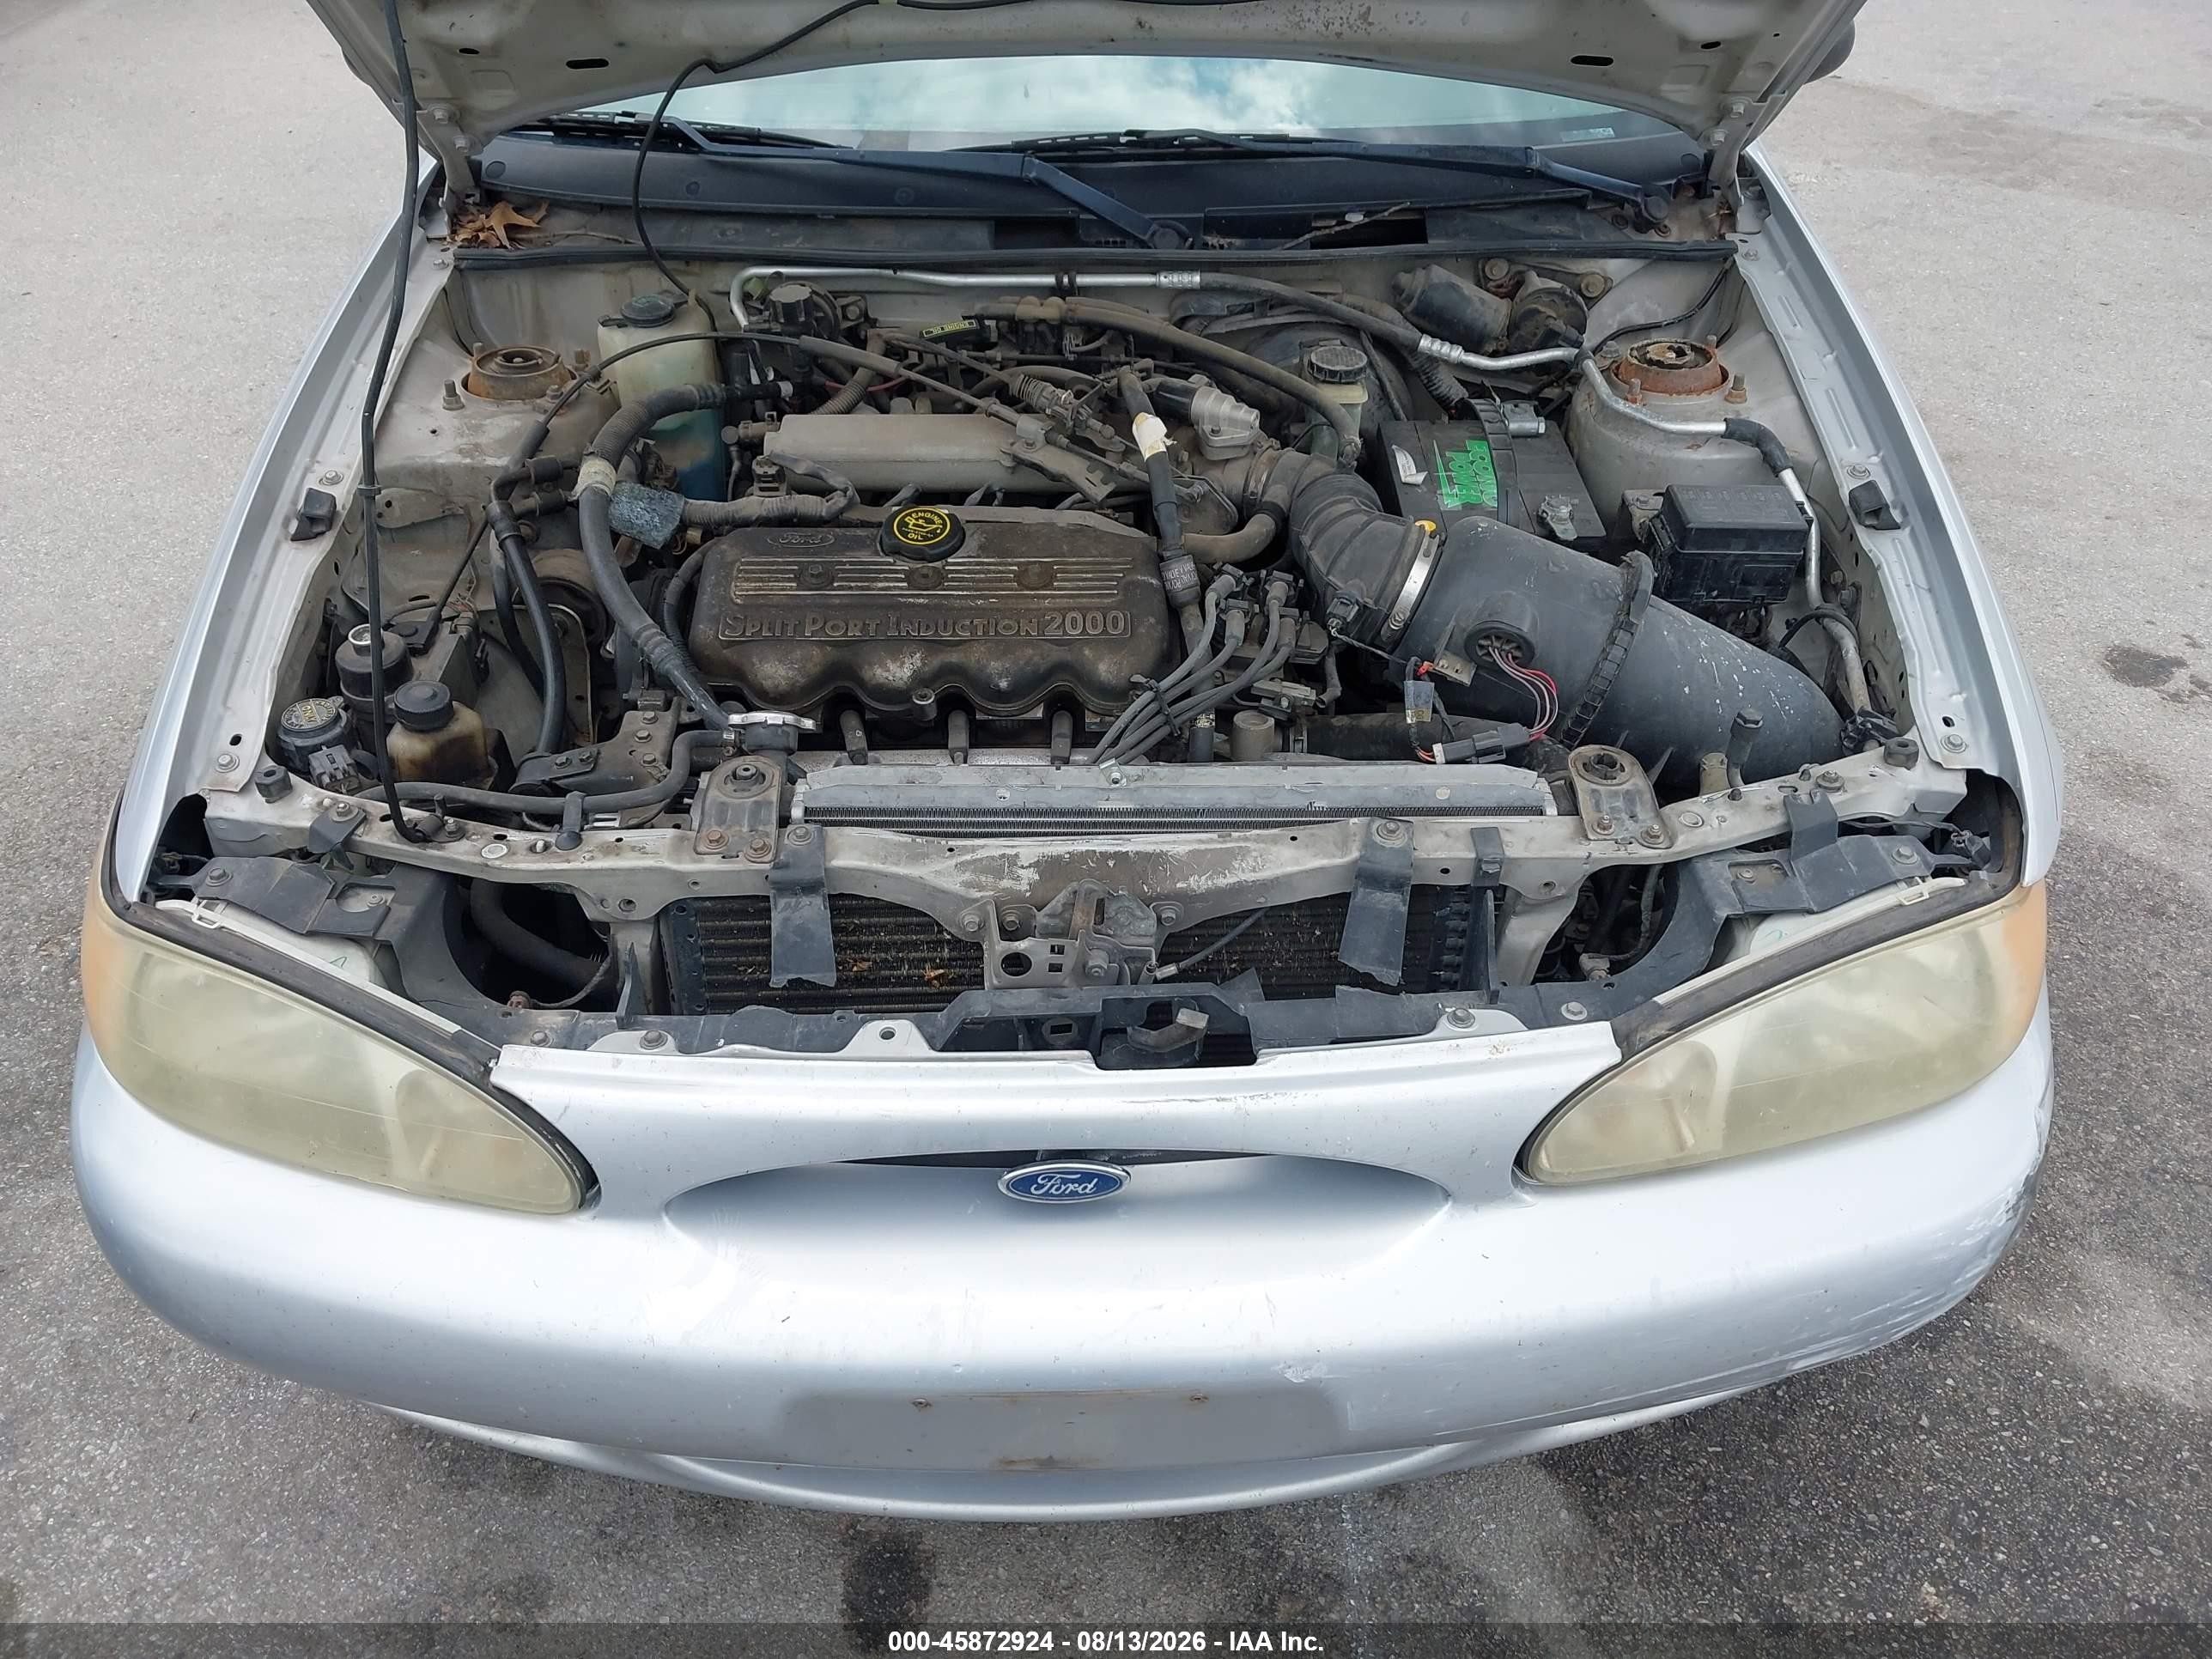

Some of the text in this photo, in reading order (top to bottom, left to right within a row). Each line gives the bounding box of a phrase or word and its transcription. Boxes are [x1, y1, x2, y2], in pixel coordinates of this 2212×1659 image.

[911, 512, 943, 525] ENGINE
[725, 611, 1125, 636] SPLIT PORT INDUCTION 2000
[1030, 1173, 1098, 1194] Ford
